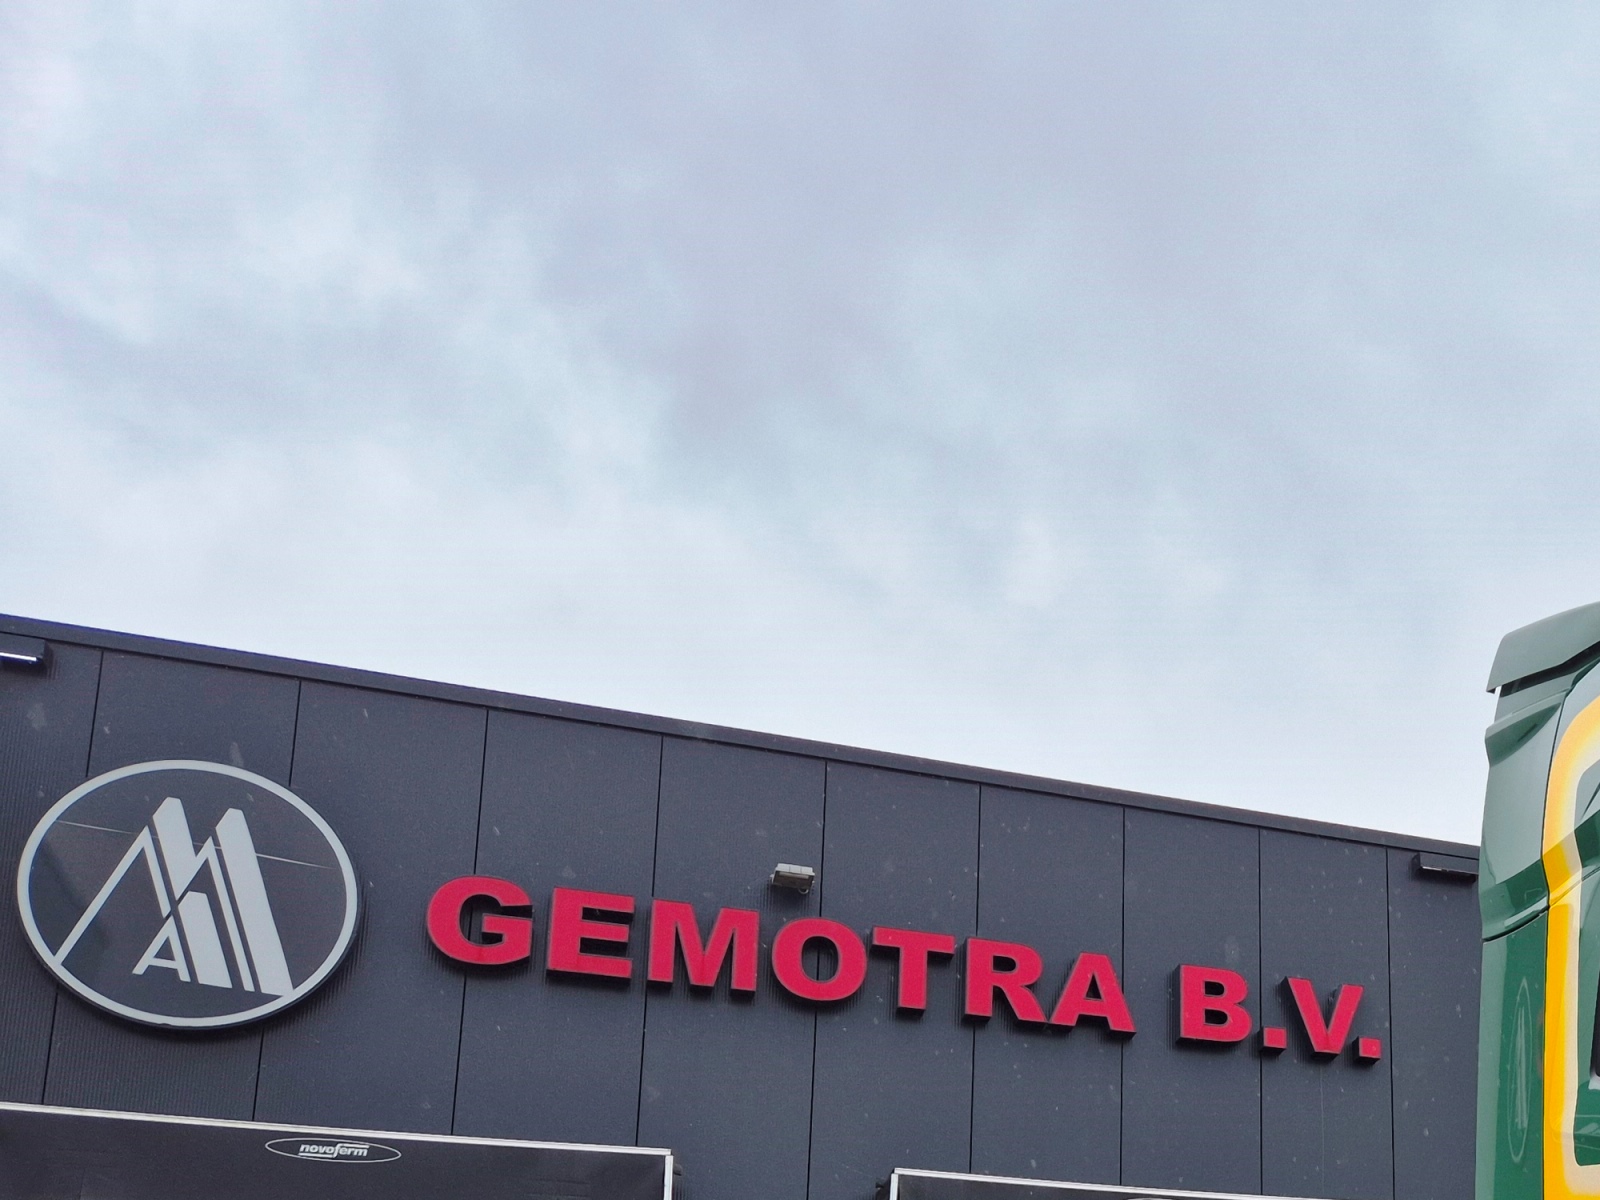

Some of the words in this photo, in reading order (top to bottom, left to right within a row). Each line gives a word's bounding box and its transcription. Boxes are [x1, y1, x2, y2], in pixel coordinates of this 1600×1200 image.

[427, 875, 1137, 1036] GEMOTRA
[1178, 963, 1382, 1061] B.V.
[298, 1143, 370, 1158] novoferm
